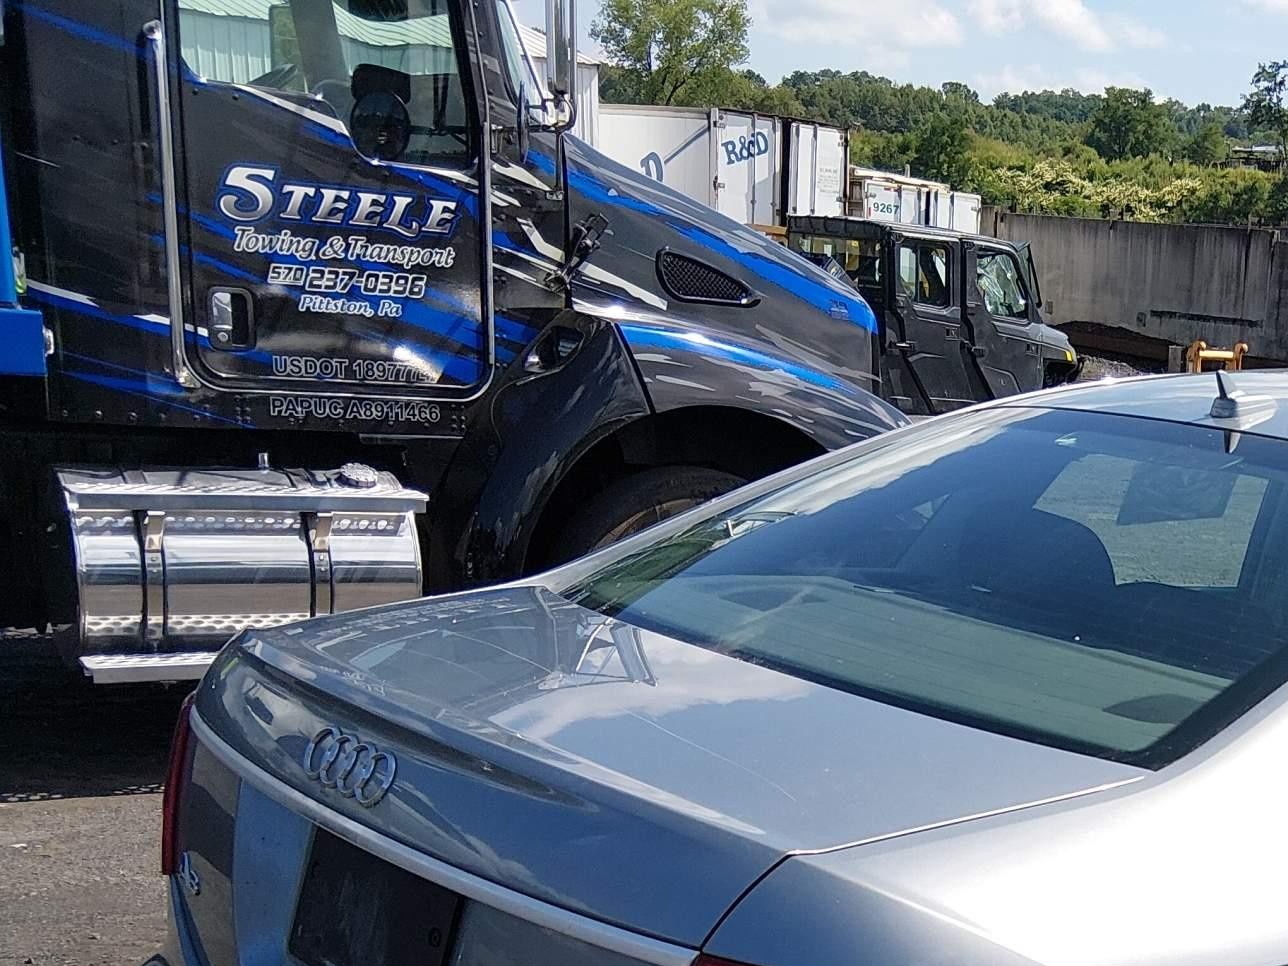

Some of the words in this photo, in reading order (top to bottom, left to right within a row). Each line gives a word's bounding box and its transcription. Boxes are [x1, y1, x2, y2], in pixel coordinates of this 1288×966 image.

[721, 131, 769, 165] R&D
[218, 165, 458, 238] STEELE
[872, 202, 900, 215] 9267
[234, 227, 318, 260] Towing
[319, 237, 346, 259] &
[348, 236, 455, 269] Transport
[267, 263, 304, 284] 570
[305, 266, 427, 299] 237-0396
[298, 295, 374, 318] Pittston,
[377, 300, 402, 317] Pa
[272, 355, 349, 379] USDOT
[269, 396, 345, 418] PAPUC
[345, 399, 441, 423] A8911466
